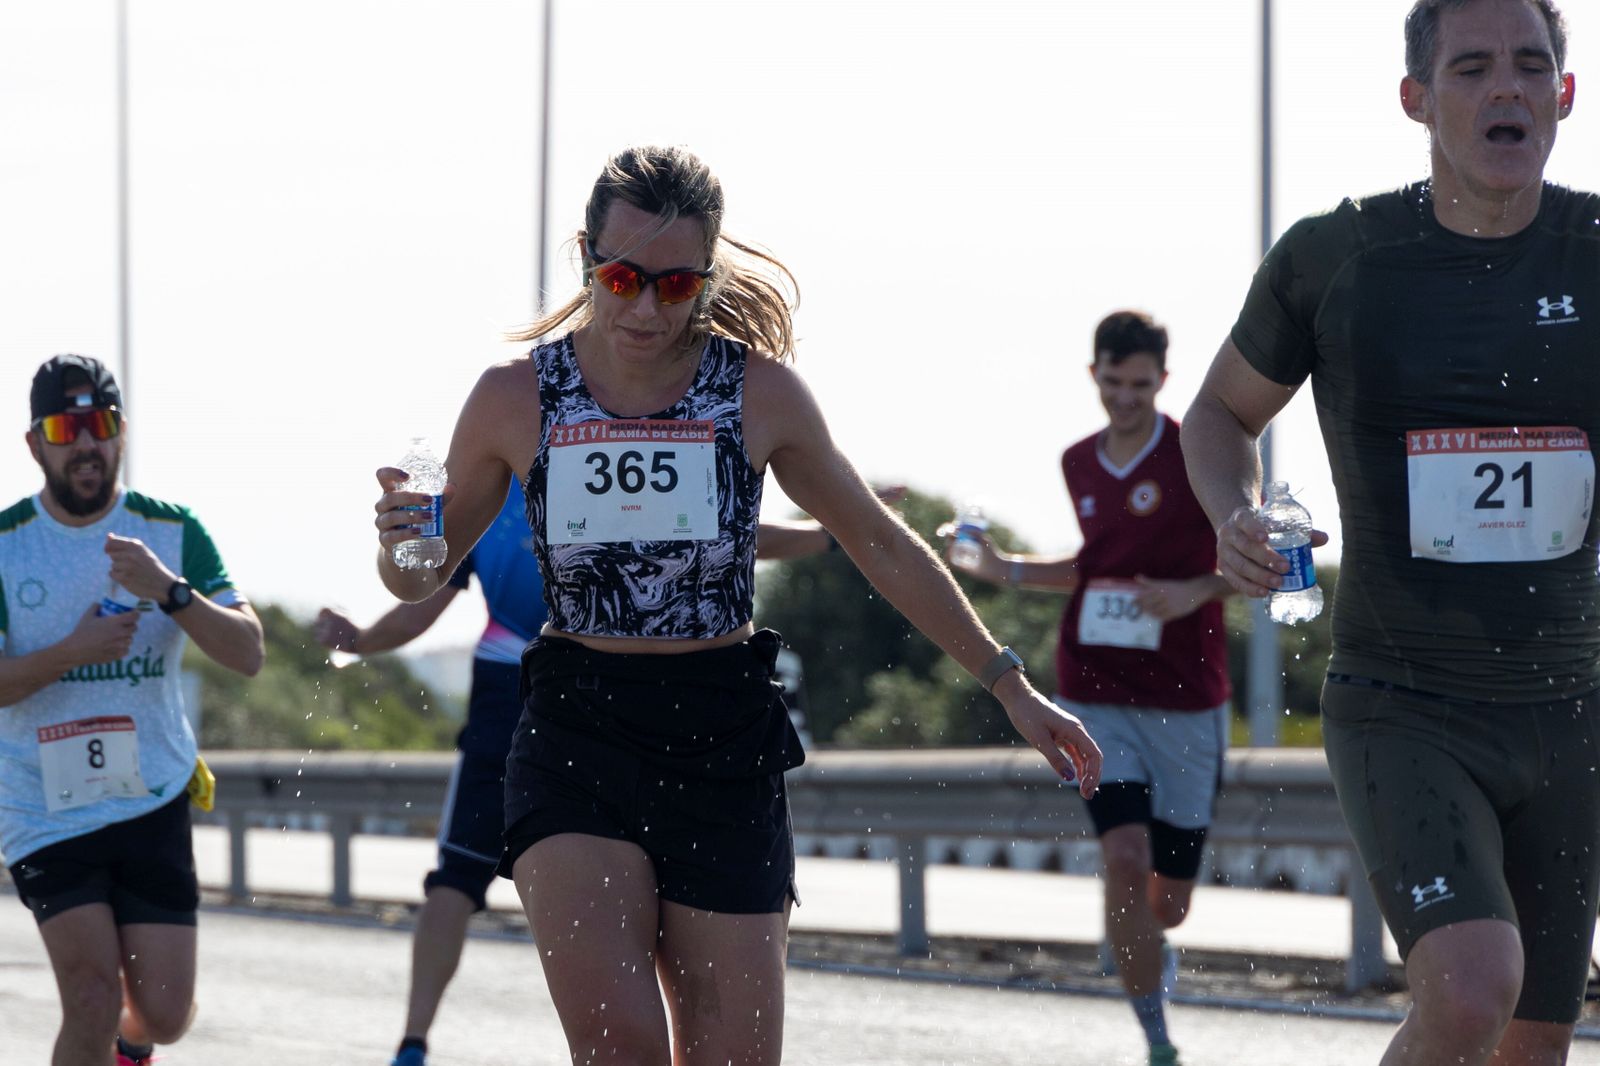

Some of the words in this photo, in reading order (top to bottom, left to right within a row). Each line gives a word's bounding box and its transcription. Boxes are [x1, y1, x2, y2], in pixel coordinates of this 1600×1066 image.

[555, 425, 606, 443] XXXVI
[609, 423, 647, 431] MEDIA
[609, 430, 649, 439] BAHÍA
[652, 431, 668, 439] DE
[671, 430, 710, 439] CÁDIZ
[1411, 432, 1475, 450] XXXVI
[1479, 438, 1524, 448] BAHÍA
[1526, 438, 1544, 448] DE
[1548, 437, 1586, 448] CÁDIZ
[584, 450, 679, 495] 365
[1473, 460, 1533, 510] 21
[567, 518, 587, 530] imd
[1477, 521, 1505, 530] JAVIER
[1433, 535, 1455, 549] imd
[88, 738, 106, 769] 8
